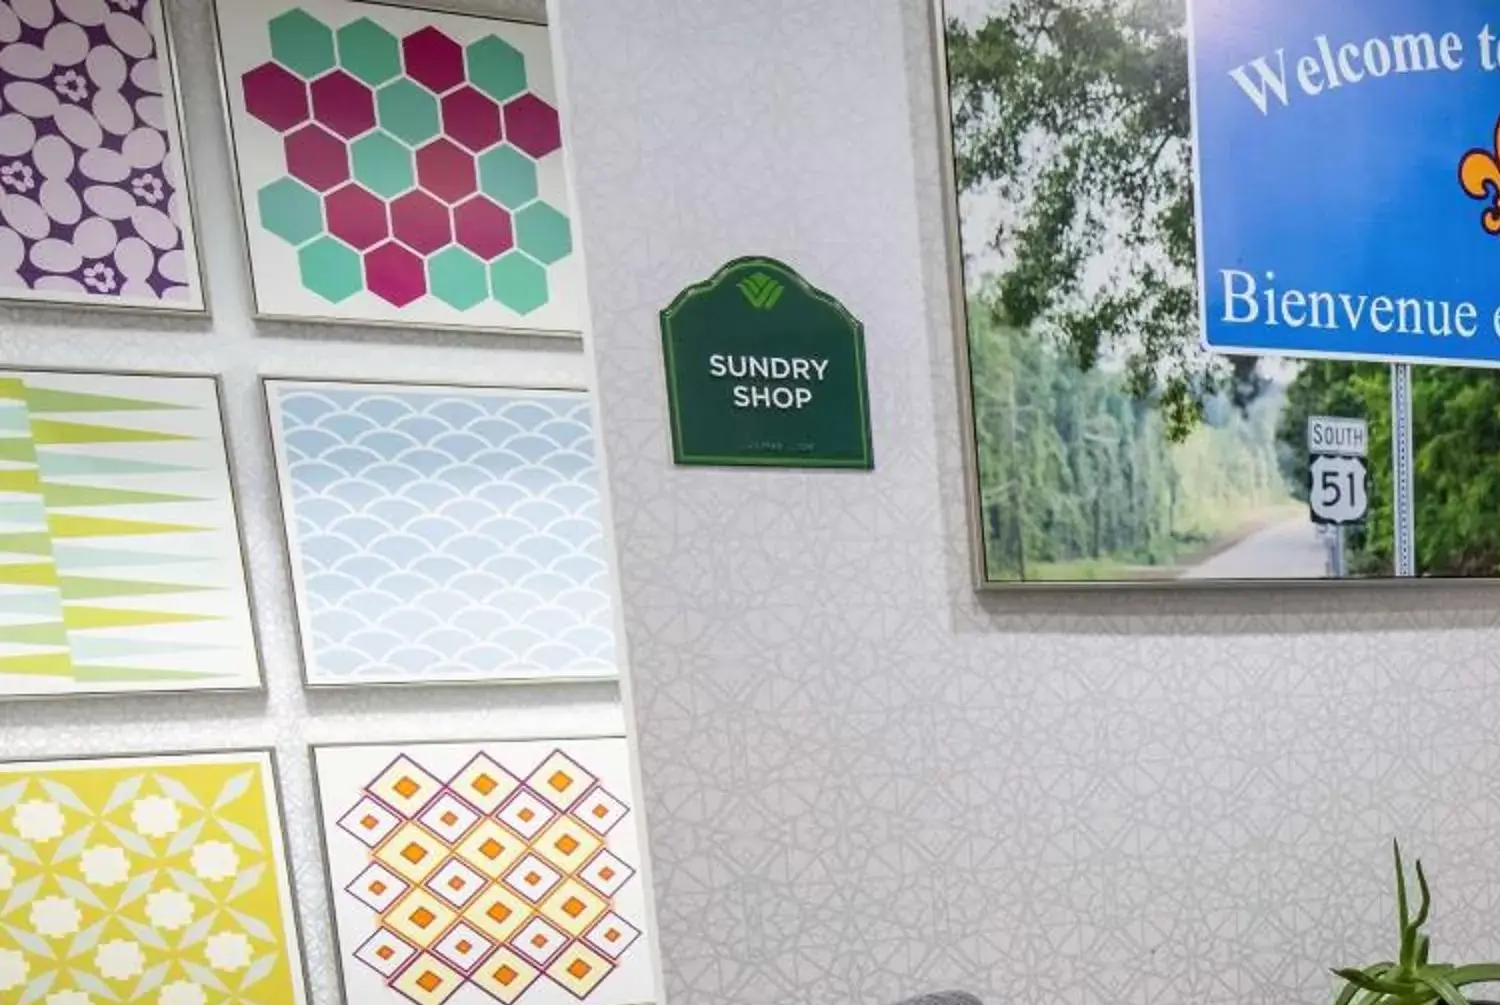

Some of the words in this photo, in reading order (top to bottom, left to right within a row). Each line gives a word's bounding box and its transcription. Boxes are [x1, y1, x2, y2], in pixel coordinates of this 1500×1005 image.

[1228, 31, 1463, 116] Welcome
[1219, 269, 1477, 338] Bienvenue
[709, 355, 829, 381] SUNDRY
[733, 386, 813, 409] SHOP
[1313, 424, 1363, 446] SOUTH
[1322, 472, 1355, 507] 51
